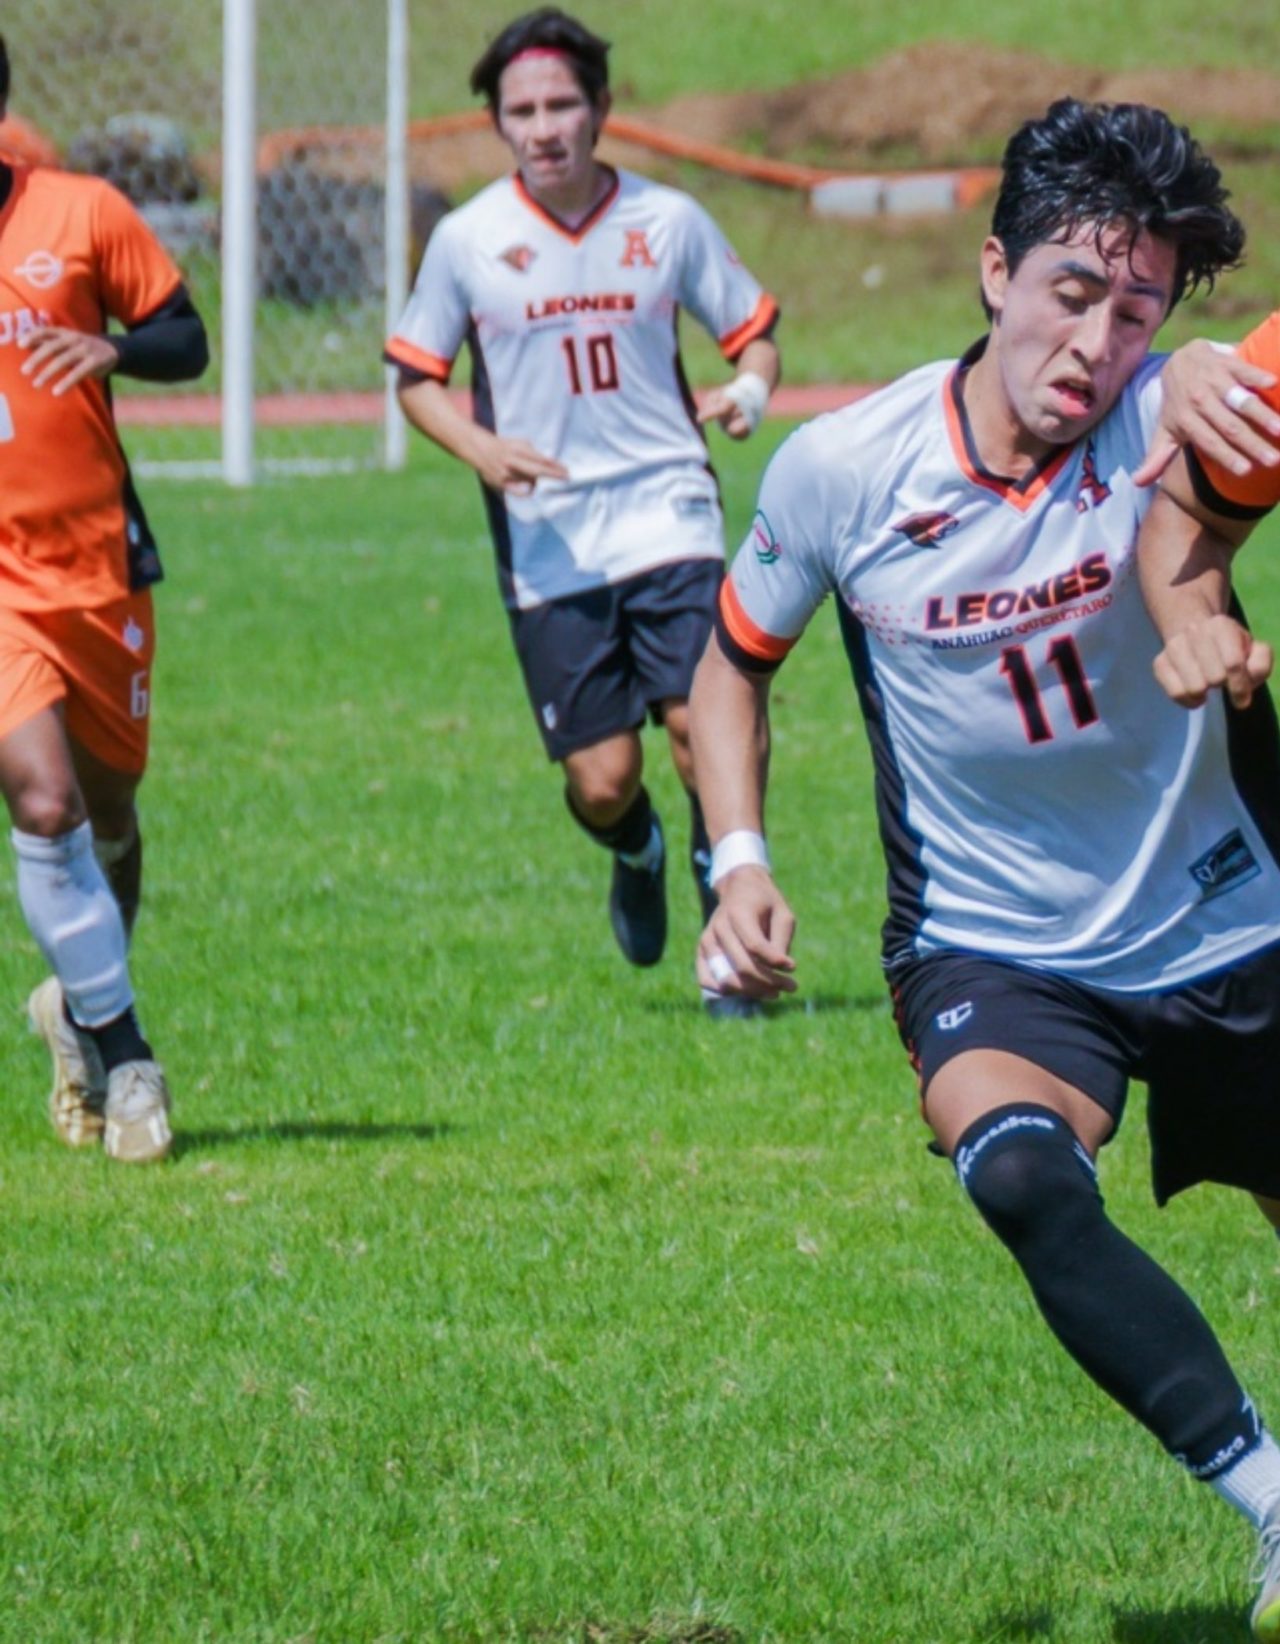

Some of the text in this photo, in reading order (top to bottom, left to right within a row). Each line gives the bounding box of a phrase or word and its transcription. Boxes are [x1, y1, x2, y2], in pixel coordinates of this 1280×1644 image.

[620, 230, 656, 268] A
[525, 293, 636, 321] LEONES
[562, 335, 620, 395] 10
[925, 551, 1113, 631] LEONES
[999, 633, 1099, 745] 11
